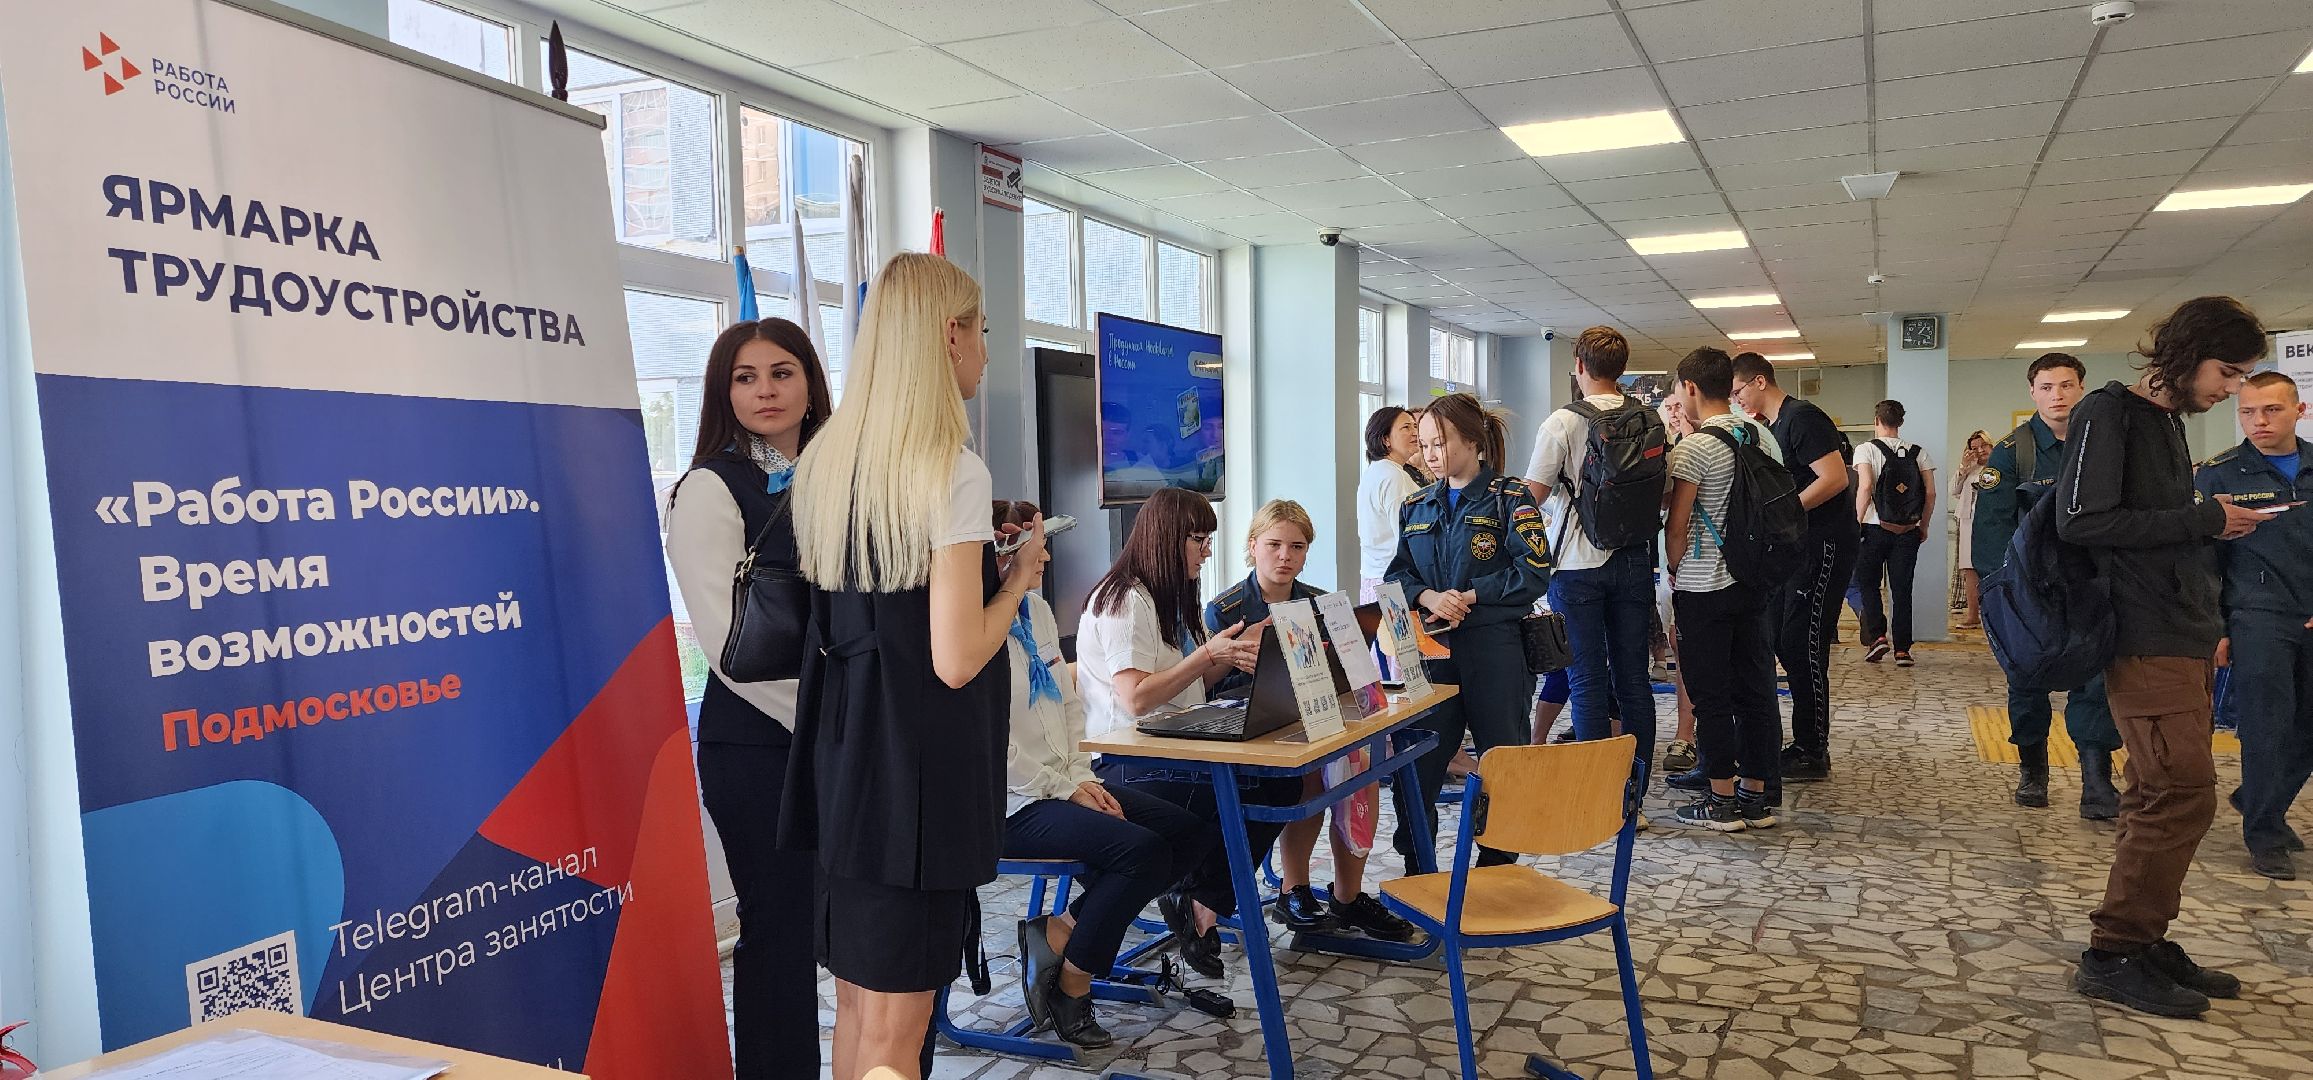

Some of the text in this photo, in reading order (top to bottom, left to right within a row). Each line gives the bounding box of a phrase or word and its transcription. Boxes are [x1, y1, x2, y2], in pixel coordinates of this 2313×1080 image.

[152, 57, 230, 94] РАБОТА
[154, 80, 236, 115] РОССИИ
[102, 174, 381, 260] ЯРМАРКА
[107, 247, 586, 346] ТРУДОУСТРОЙСТВА
[95, 477, 540, 527] «Работа России».
[139, 555, 330, 609] Время
[148, 592, 523, 678] возможностей
[161, 673, 462, 752] Подмосковье
[328, 846, 598, 958] Telegram-канал
[338, 880, 635, 1017] Центра занятости
